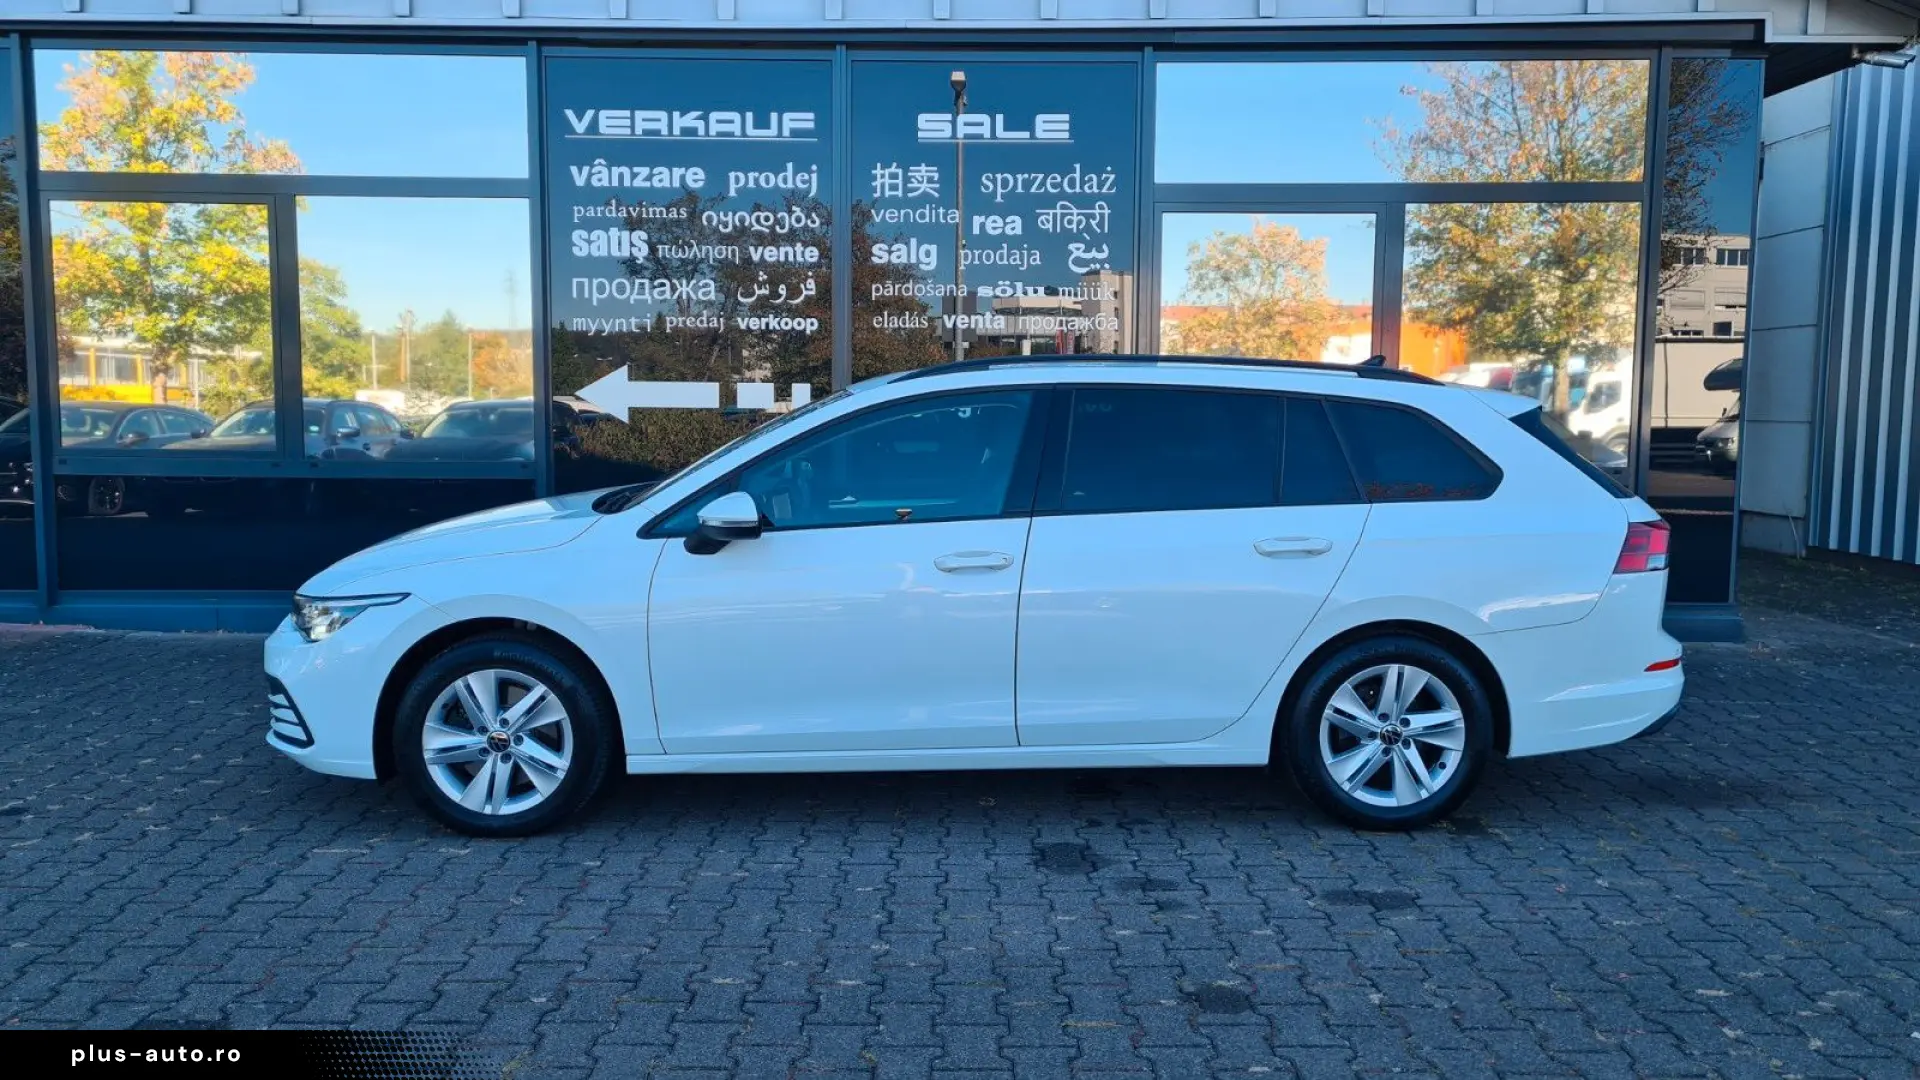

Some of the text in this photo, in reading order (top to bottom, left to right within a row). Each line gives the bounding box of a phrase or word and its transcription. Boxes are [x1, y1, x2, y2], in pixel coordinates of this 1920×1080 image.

[564, 109, 815, 136] VERKAUF
[918, 113, 1070, 138] SALE
[570, 158, 817, 197] vânzare prodej
[871, 161, 940, 198] 拍卖
[980, 163, 1116, 202] sprzedaż
[573, 199, 687, 222] pardavimas
[871, 205, 1022, 235] vendita rea
[571, 228, 648, 263] satış
[657, 240, 739, 264] πώληση
[749, 242, 819, 262] vente
[871, 238, 1041, 271] salg prodaja
[1067, 242, 1110, 274] بيع
[572, 278, 715, 305] продажа
[737, 271, 816, 304] فروش
[871, 280, 1115, 301] pārdošana sölu müük
[573, 311, 818, 335] myynti predaj verkoop
[873, 312, 1005, 330] eladás venta
[1018, 312, 1118, 333] продажба
